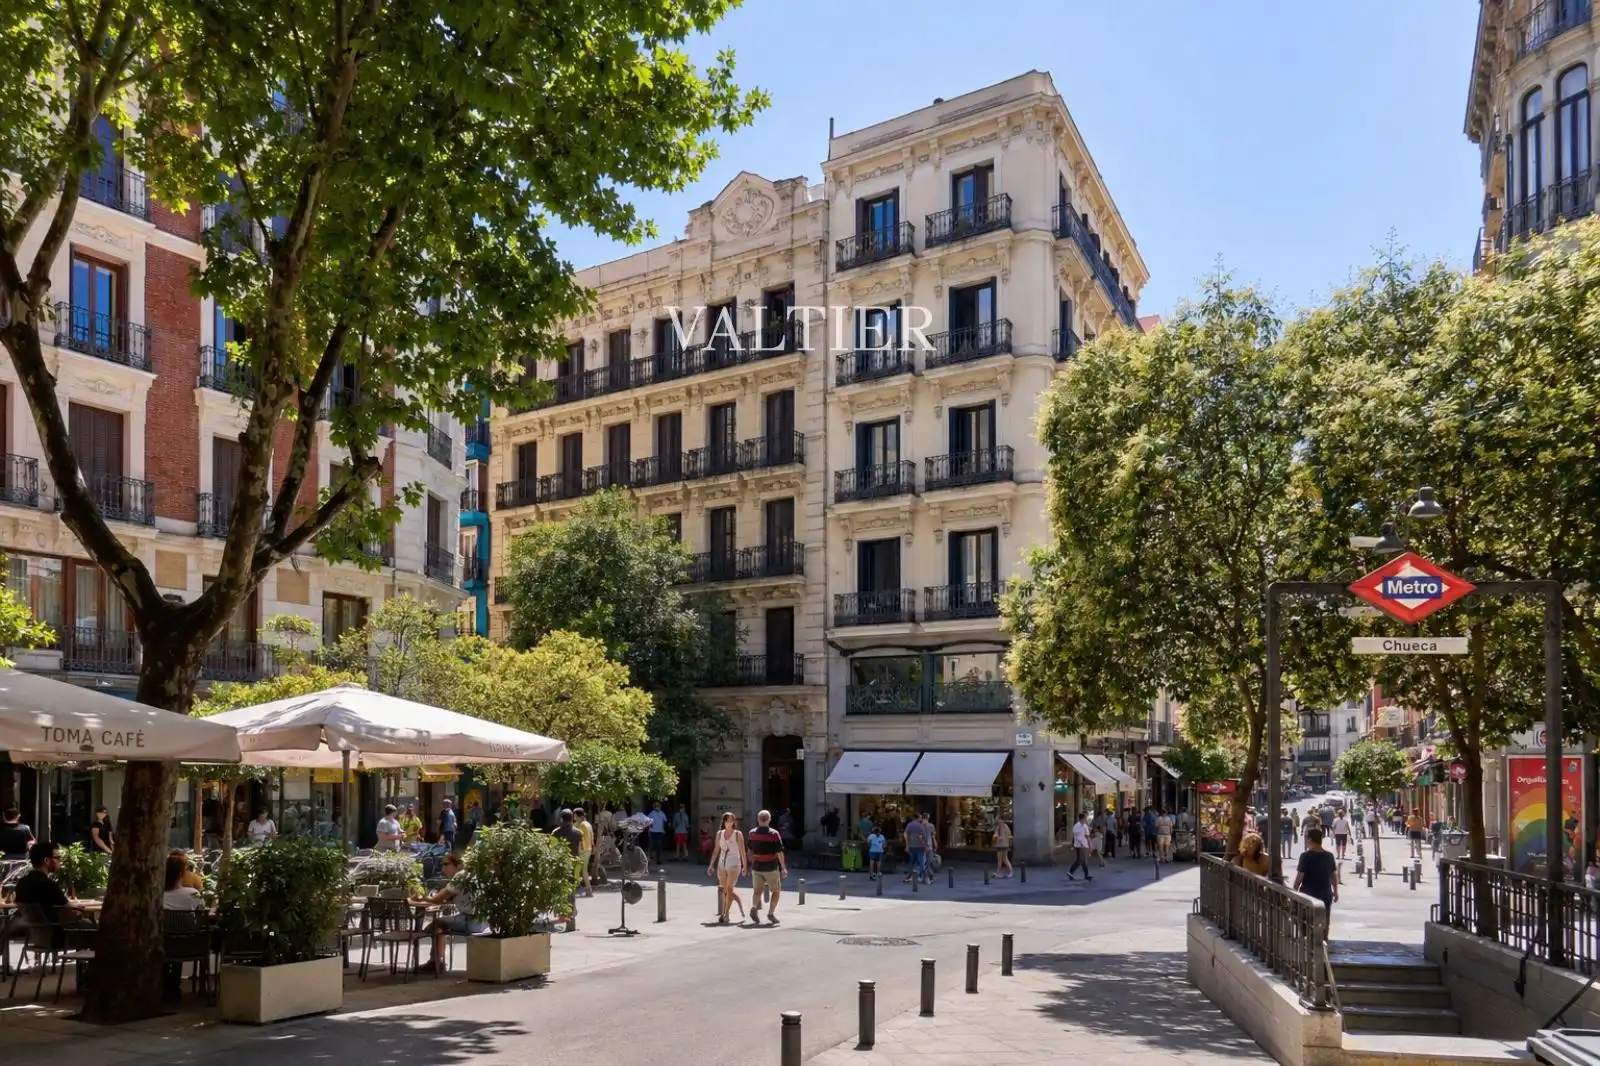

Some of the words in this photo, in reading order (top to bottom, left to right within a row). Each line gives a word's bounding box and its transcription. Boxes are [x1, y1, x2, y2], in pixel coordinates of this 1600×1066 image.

[1387, 579, 1438, 595] Metro
[1382, 639, 1438, 651] Chueca
[41, 726, 94, 744] TOMA
[102, 729, 145, 748] CAFÉ
